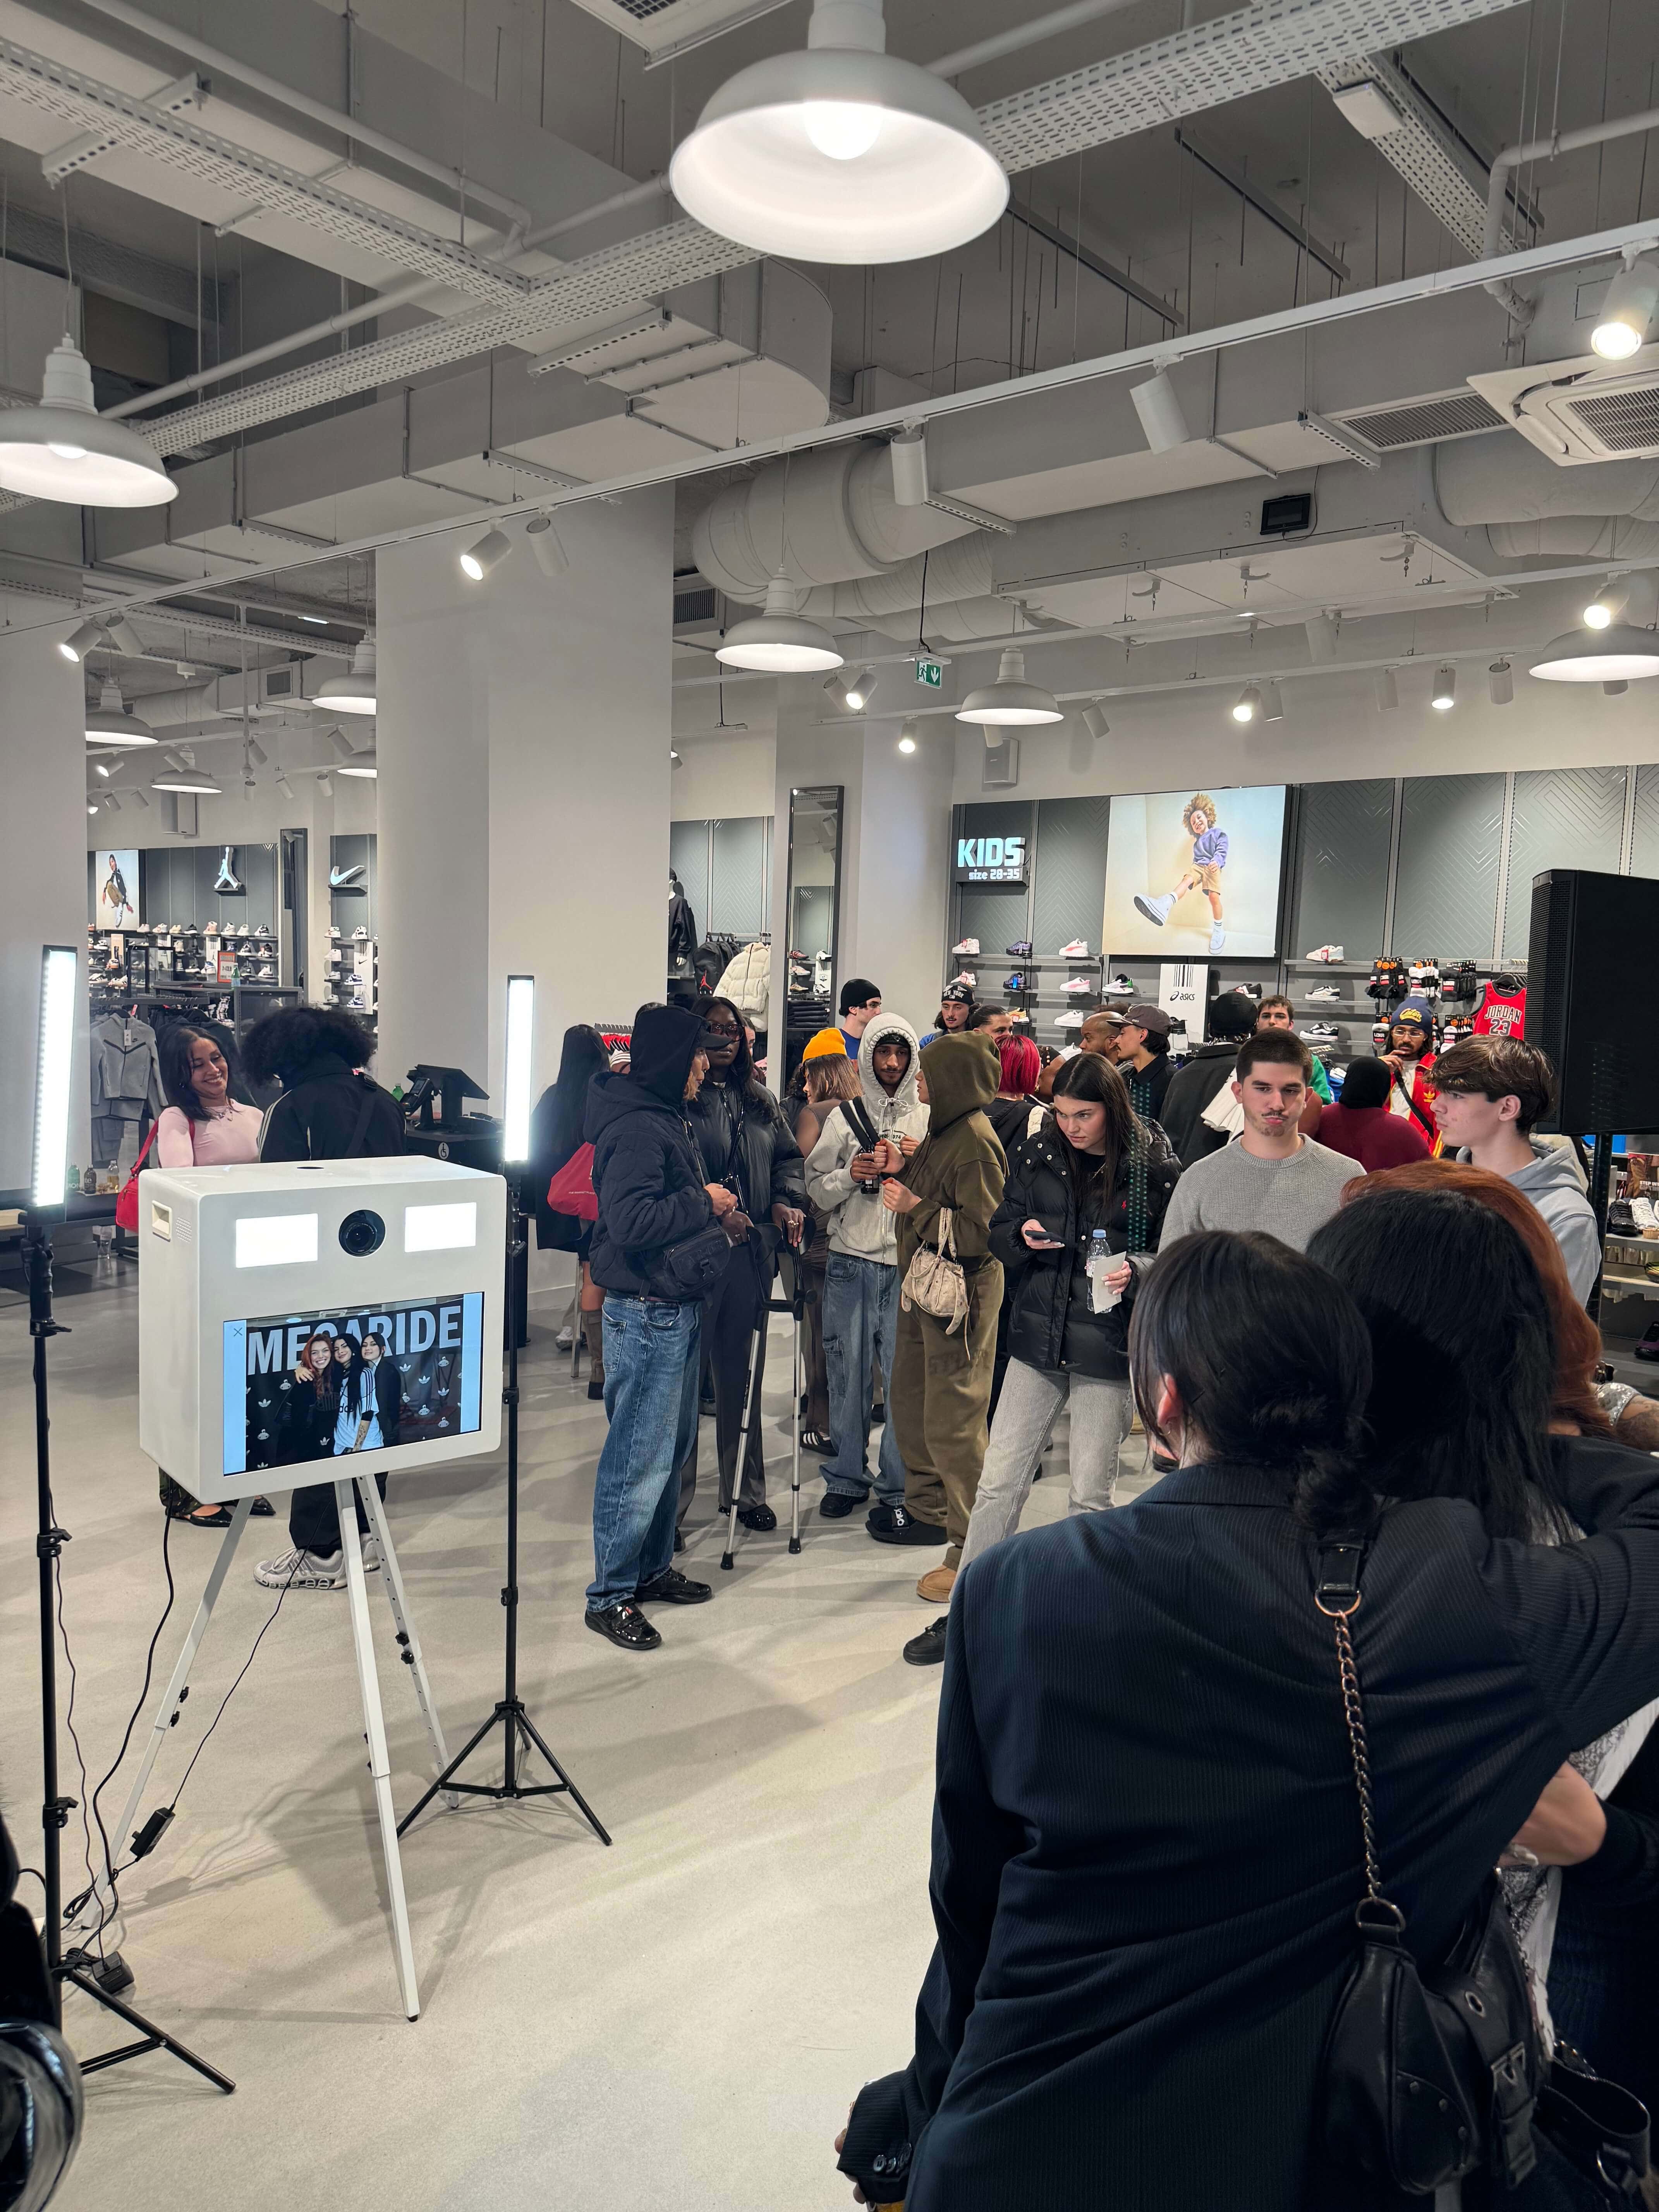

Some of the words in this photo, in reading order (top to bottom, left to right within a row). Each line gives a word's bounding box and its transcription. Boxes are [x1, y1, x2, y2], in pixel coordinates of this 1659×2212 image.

[957, 837, 1025, 867] KIDS
[969, 869, 988, 880] size
[990, 869, 1020, 880] 28-35
[953, 989, 964, 998] YORK
[1484, 1005, 1522, 1024] JORDAN
[1489, 1017, 1512, 1036] 23
